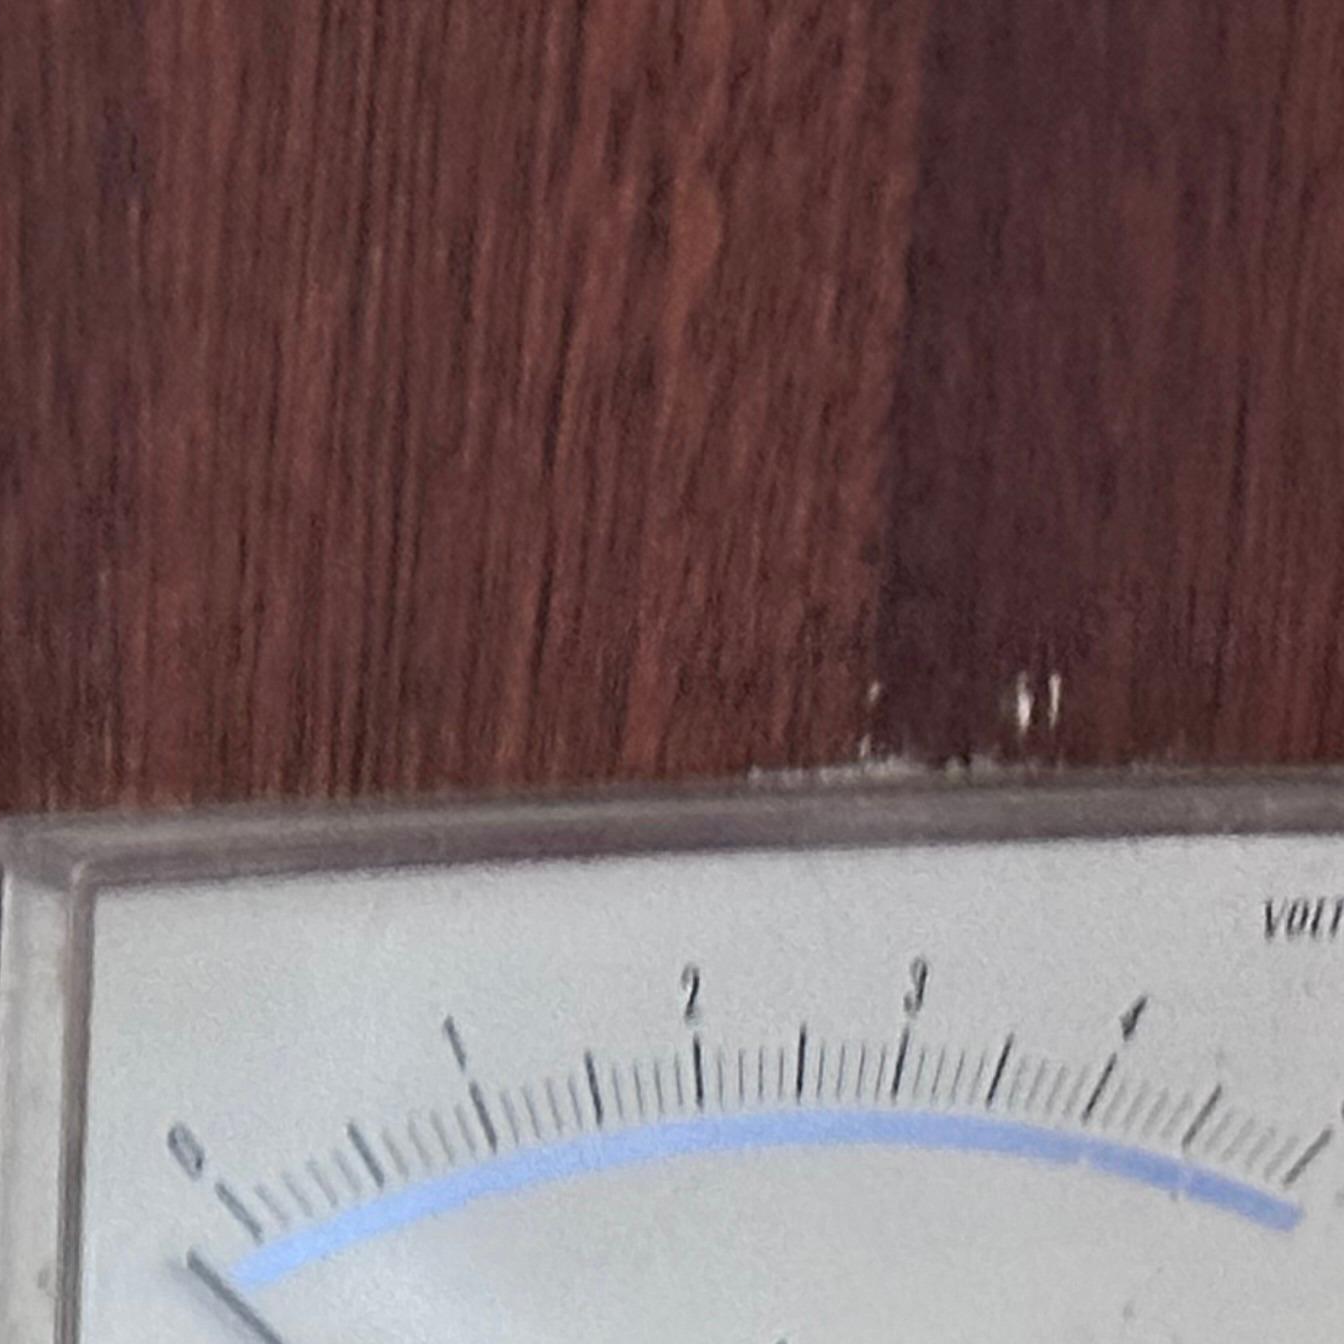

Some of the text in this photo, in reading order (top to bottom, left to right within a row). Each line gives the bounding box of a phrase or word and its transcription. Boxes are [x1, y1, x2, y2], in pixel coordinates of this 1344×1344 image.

[167, 1124, 205, 1182] 0
[443, 1015, 467, 1073] 1
[680, 961, 703, 1029] 2
[903, 955, 929, 1020] 3
[1119, 995, 1149, 1042] 4
